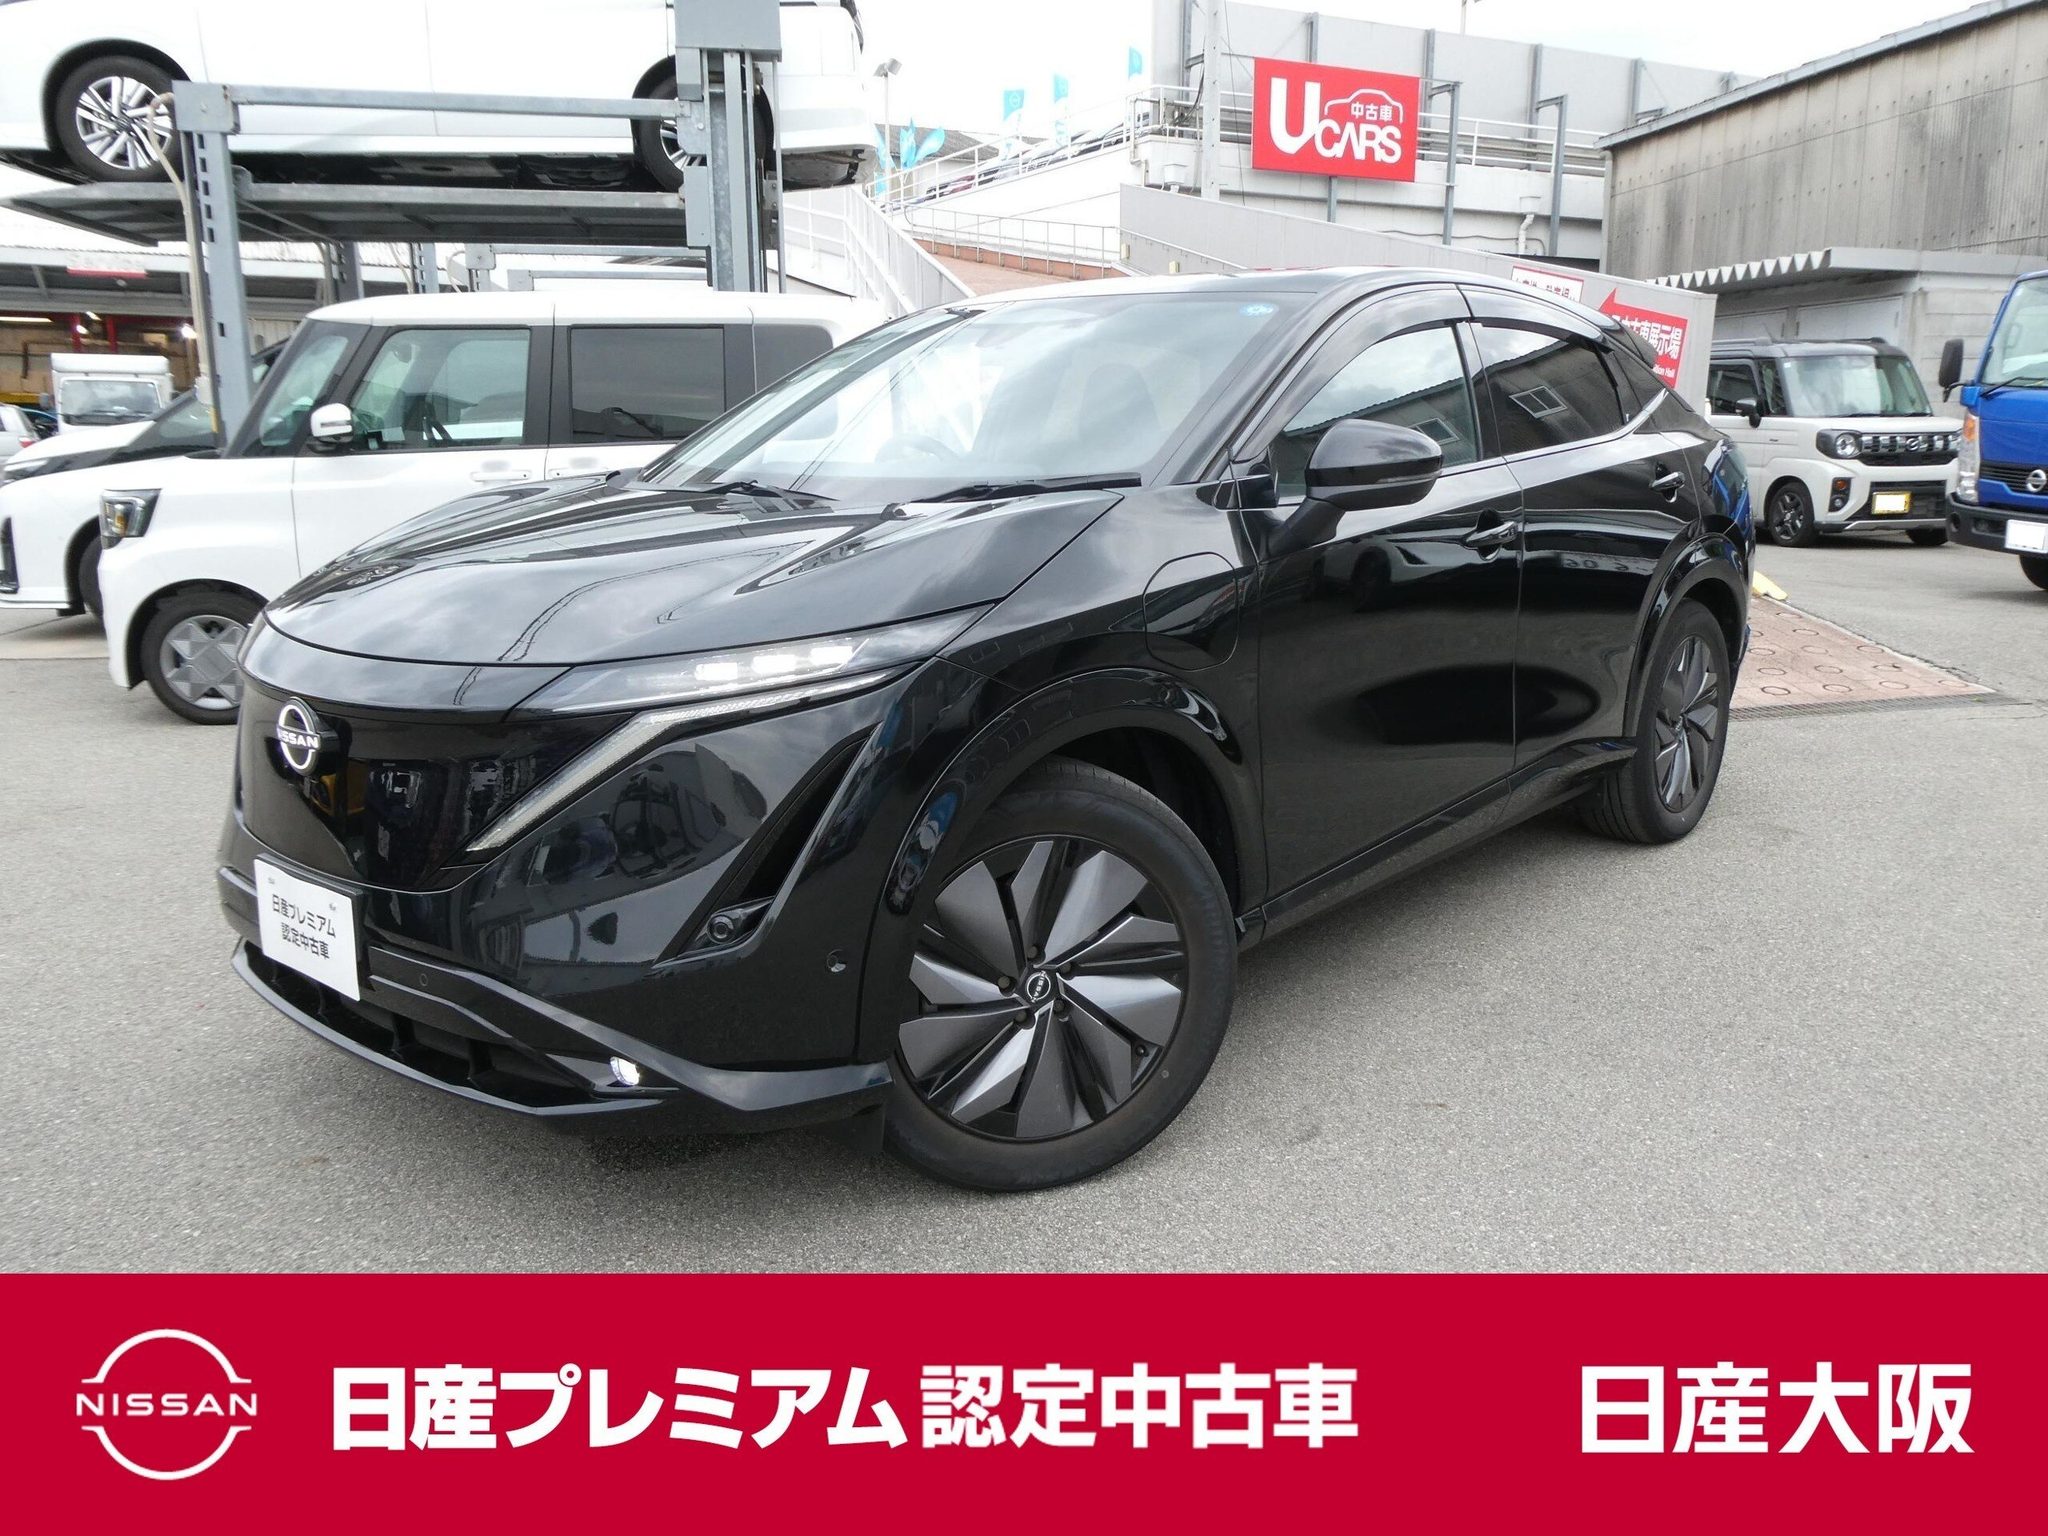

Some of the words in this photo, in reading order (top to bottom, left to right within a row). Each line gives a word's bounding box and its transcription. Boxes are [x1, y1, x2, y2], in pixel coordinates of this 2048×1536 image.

[1351, 102, 1393, 121] 中古車
[271, 893, 337, 938] 日産プレミアム
[280, 921, 330, 960] 認定中古車
